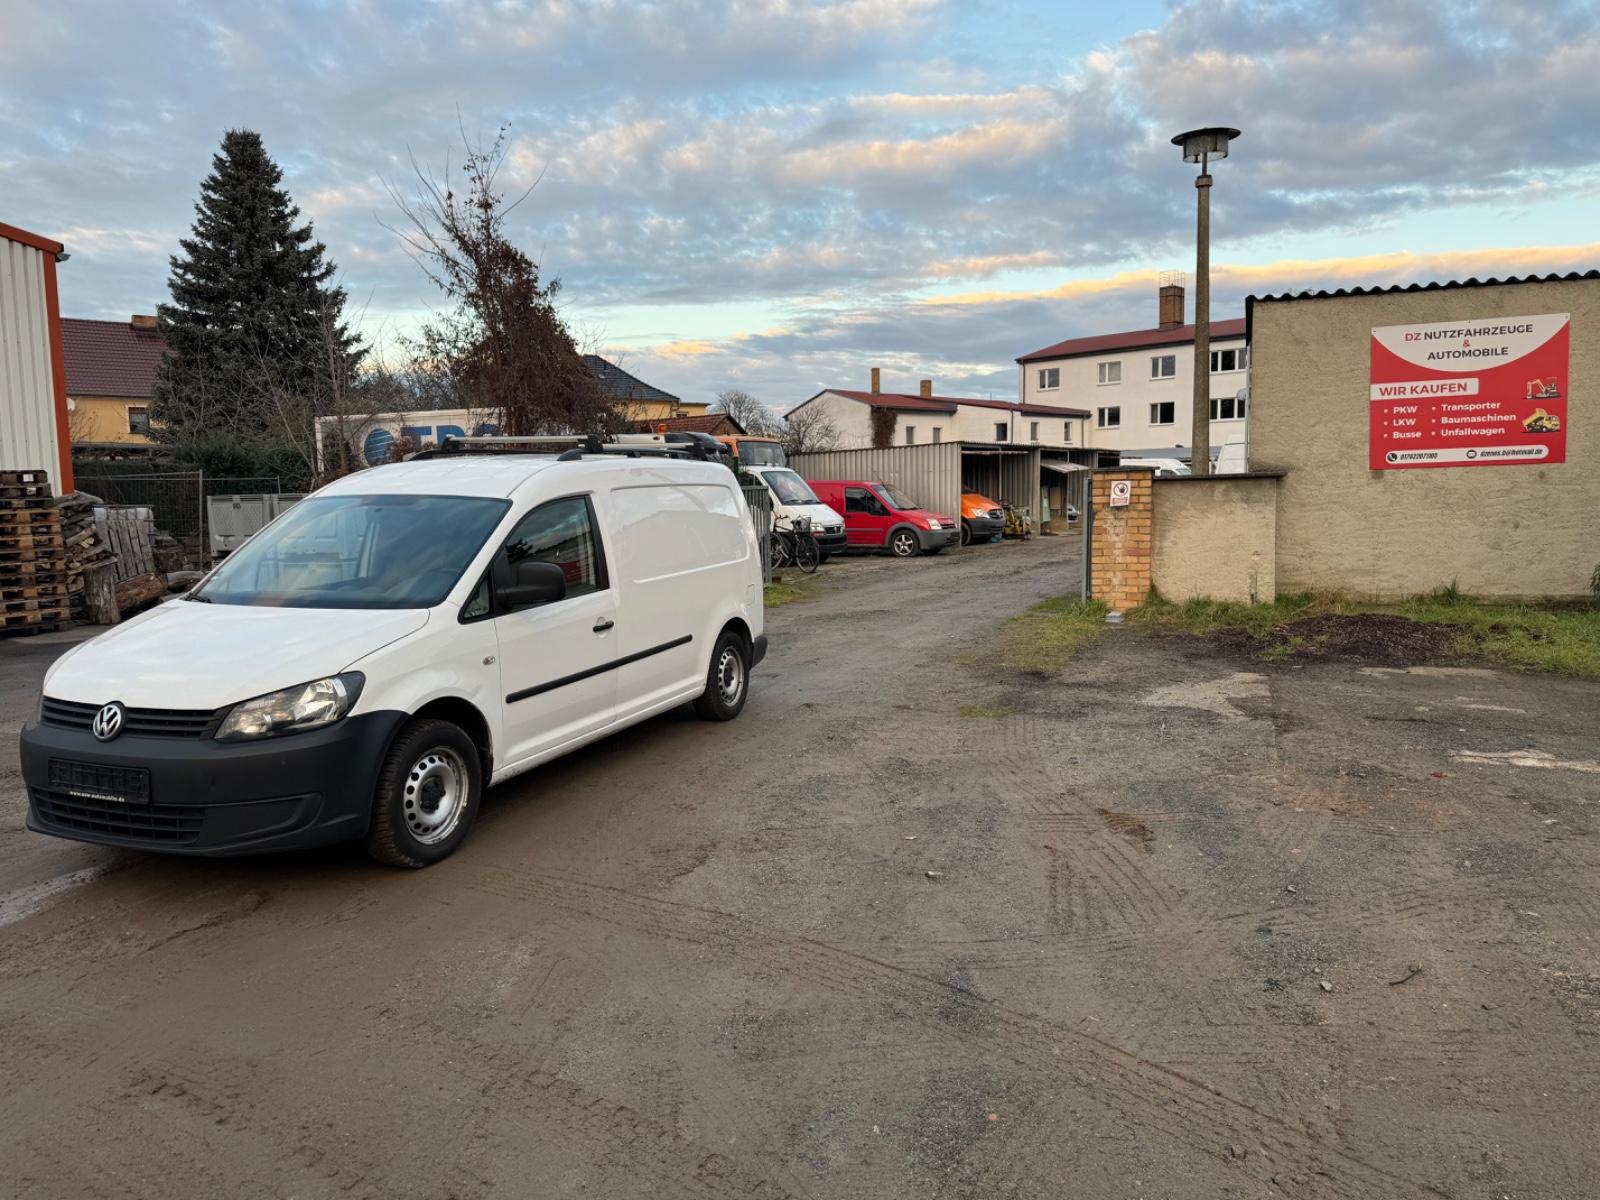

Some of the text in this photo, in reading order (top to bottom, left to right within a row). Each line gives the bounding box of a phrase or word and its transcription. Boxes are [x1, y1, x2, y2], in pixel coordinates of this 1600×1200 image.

[1405, 324, 1533, 342] DZ NUTZFAHRZEUGE
[1462, 339, 1470, 348] &
[1427, 347, 1509, 361] AUTOMOBILE
[1379, 382, 1467, 397] WIR KAUFEN
[1393, 405, 1418, 415] PKW
[1441, 402, 1501, 413] Transporter
[1393, 418, 1416, 427] LKW
[1441, 413, 1517, 425] Baumaschinen
[1393, 431, 1422, 440] Busse
[1440, 427, 1505, 438] Unfallwagen
